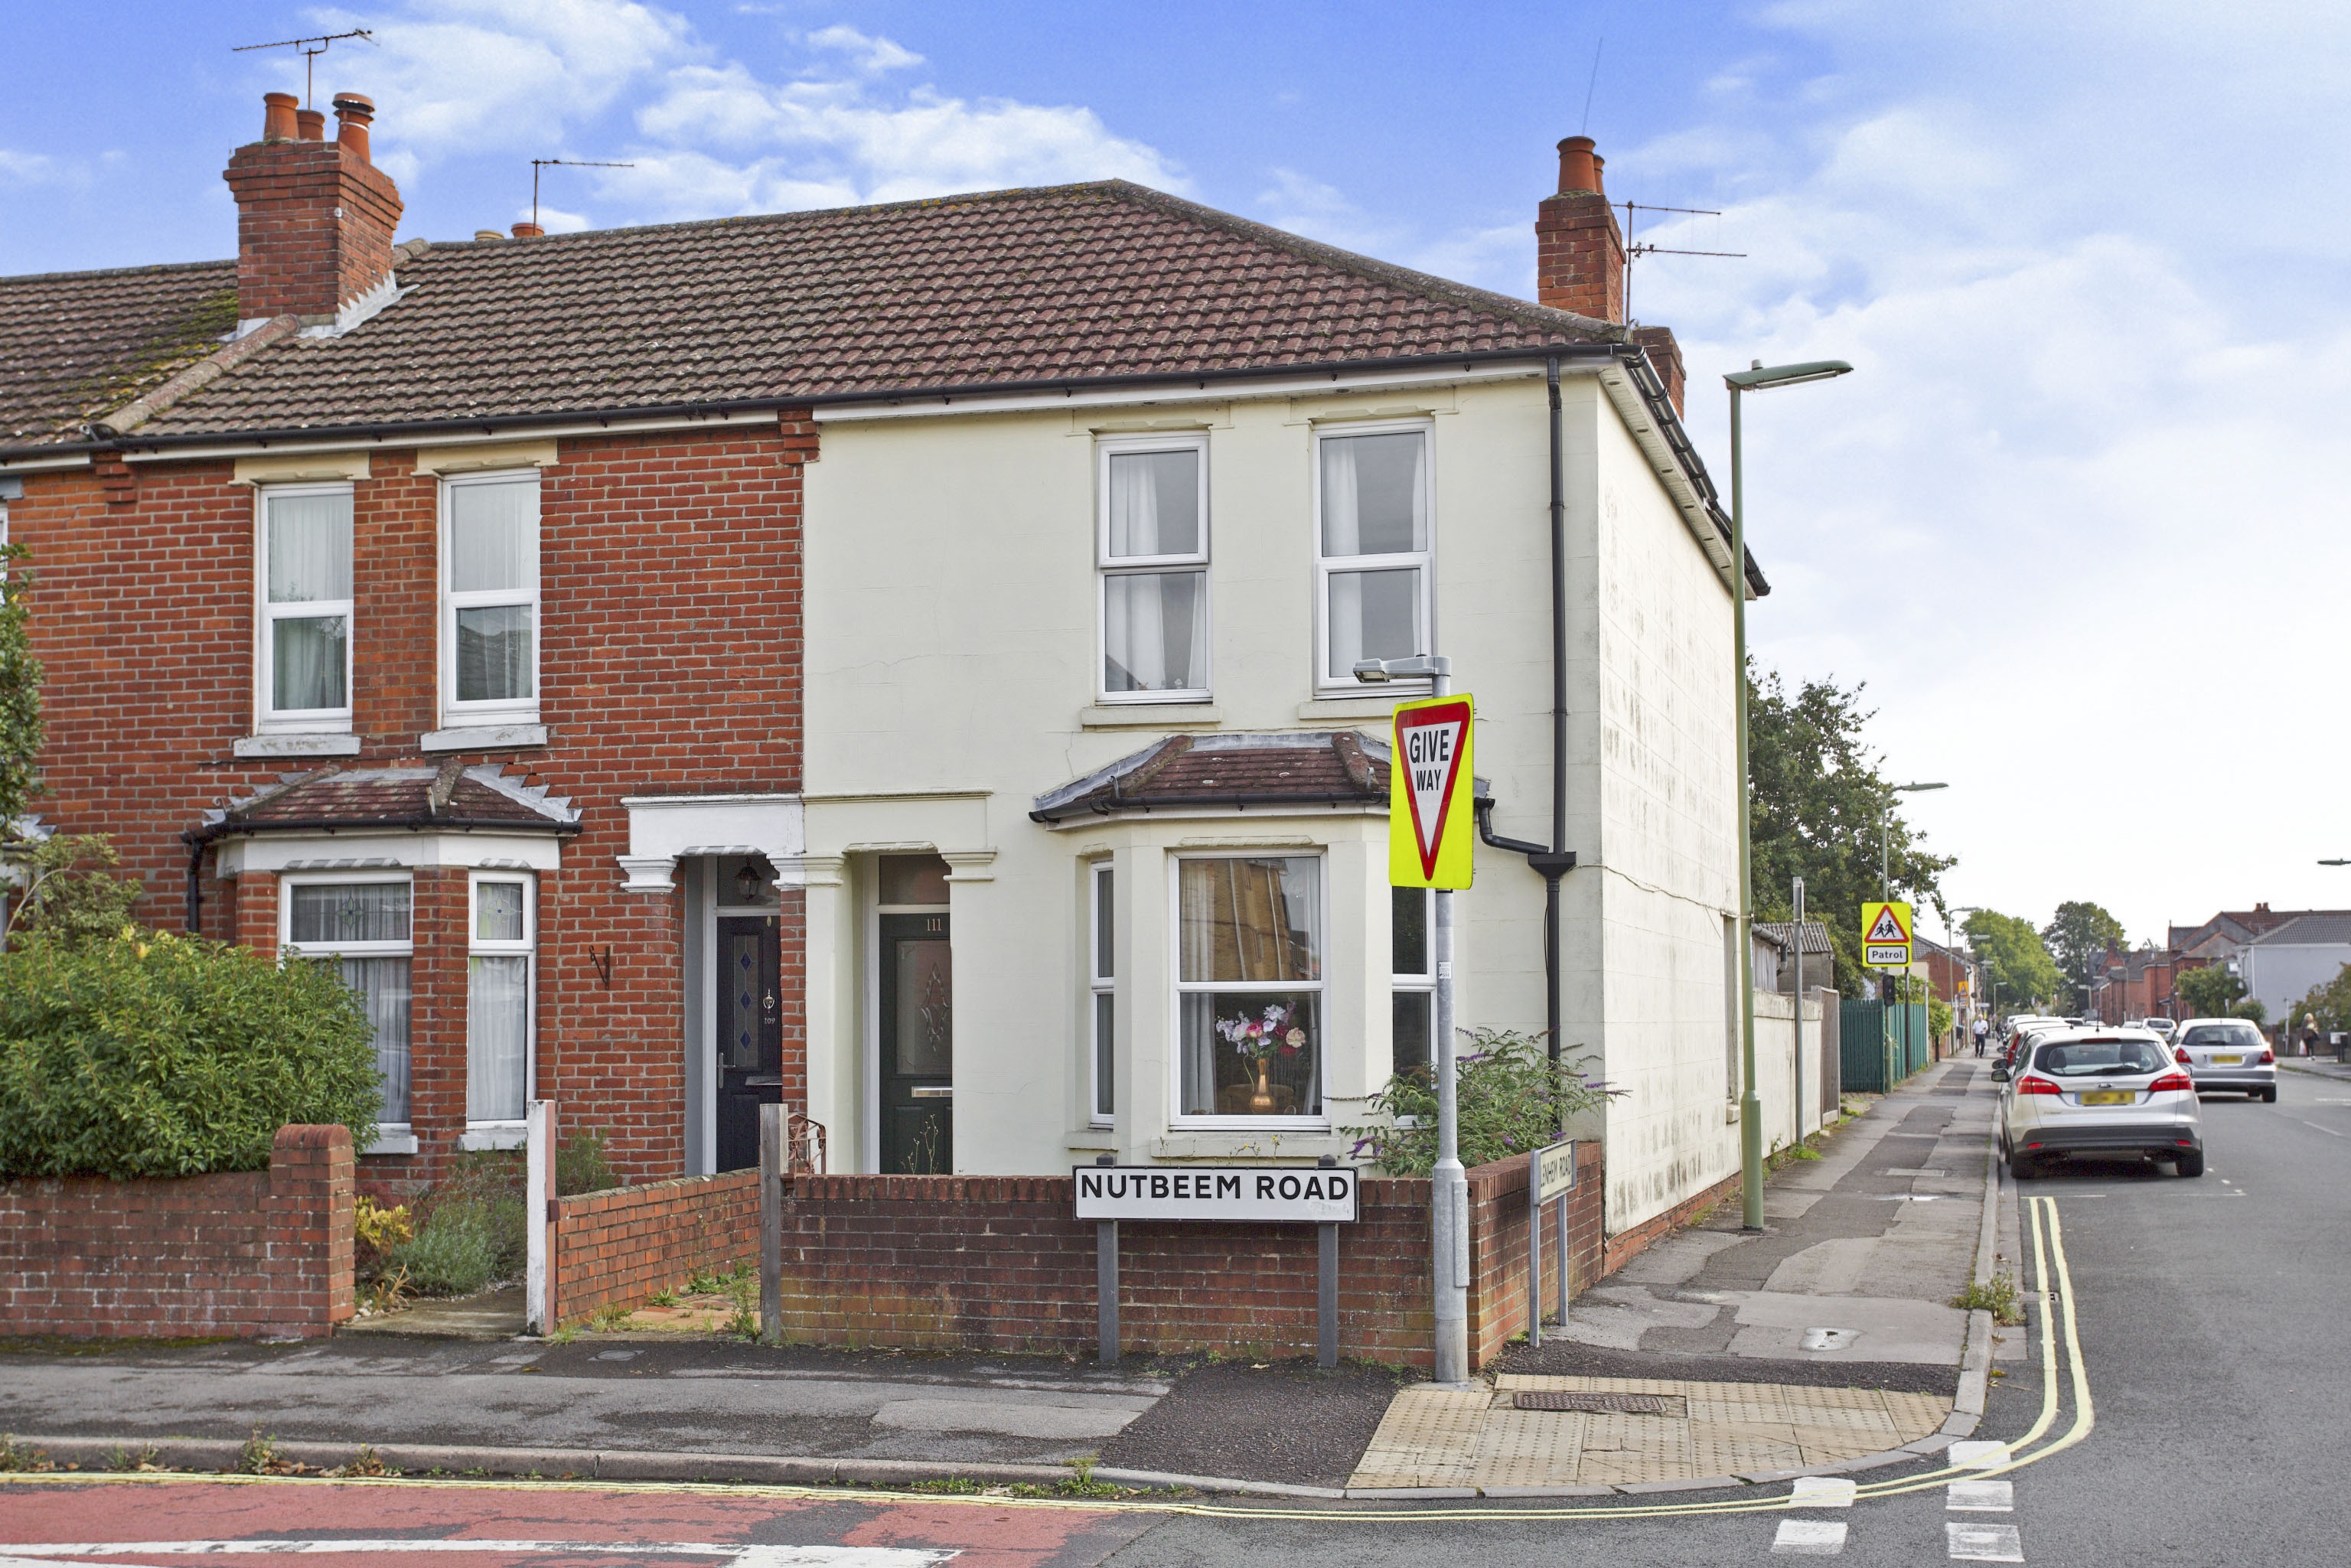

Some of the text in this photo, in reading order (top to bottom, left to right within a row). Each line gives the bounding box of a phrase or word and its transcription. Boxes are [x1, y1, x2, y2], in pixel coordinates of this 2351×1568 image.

[1410, 729, 1449, 764] GIVE
[1417, 769, 1441, 791] WAY
[926, 918, 941, 931] 111
[1872, 950, 1903, 959] Patrol
[1559, 1153, 1571, 1179] ROAD
[1081, 1175, 1348, 1200] NUTBEEM ROAD
